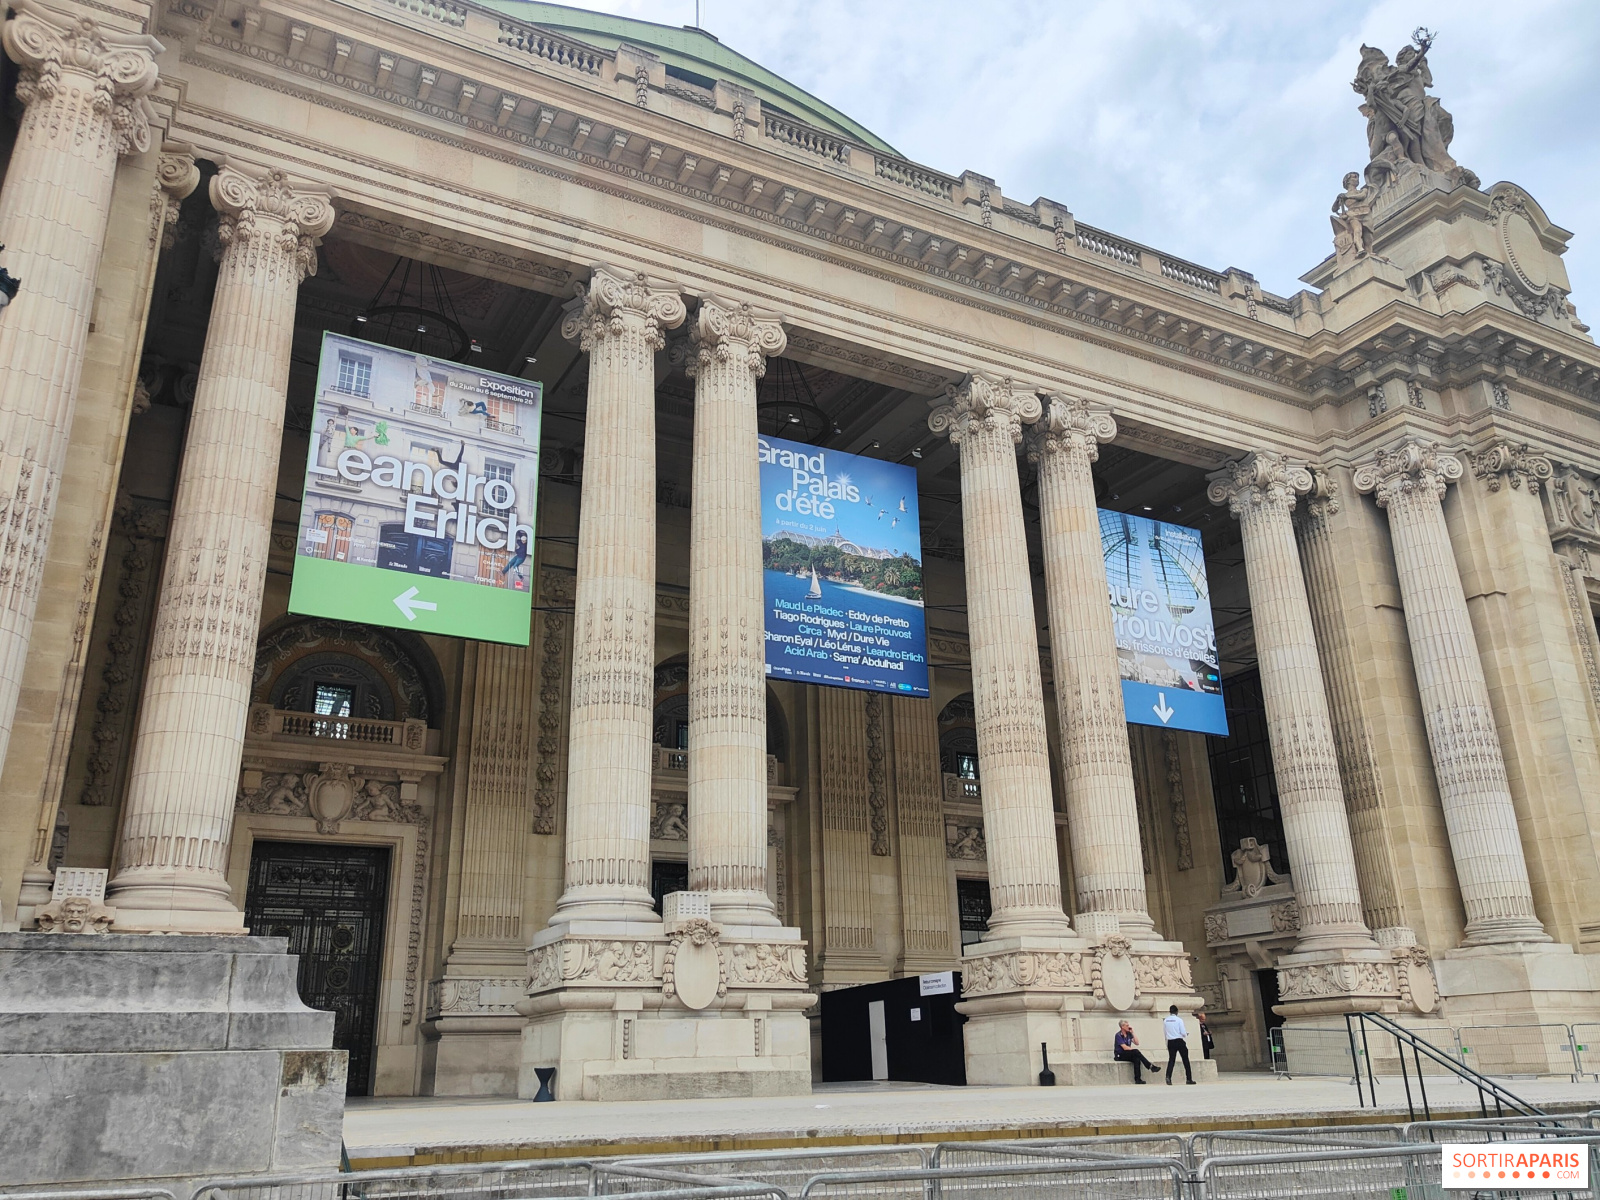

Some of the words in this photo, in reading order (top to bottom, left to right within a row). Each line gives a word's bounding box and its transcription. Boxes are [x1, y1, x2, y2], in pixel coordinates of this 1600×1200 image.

[463, 383, 475, 392] juin
[490, 391, 524, 402] septembre
[480, 378, 534, 398] Exposition
[307, 432, 516, 510] Leandro
[758, 438, 825, 475] Grand
[792, 468, 860, 503] Palais
[775, 489, 835, 520] d'été
[404, 493, 534, 555] Erlich
[800, 521, 808, 529] du
[815, 525, 827, 533] juin
[1108, 583, 1159, 613] aure
[773, 610, 799, 622] Tiago
[800, 613, 845, 629] Rodrigues
[850, 621, 873, 633] Laure
[874, 625, 912, 639] Prouvost
[775, 599, 800, 611] Maud
[802, 602, 812, 612] Le
[814, 604, 844, 617] Pladec
[848, 610, 870, 623] Eddy
[872, 613, 884, 623] de
[884, 616, 910, 628] Pretto
[764, 631, 794, 643] Sharon
[795, 635, 813, 647] Eyal
[819, 638, 836, 649] Léo
[837, 641, 861, 653] Lérus
[866, 646, 901, 659] Leandro
[901, 651, 924, 663] Erlich
[798, 624, 822, 636] Circa
[827, 629, 847, 641] Myd
[853, 632, 874, 644] Dure
[876, 635, 890, 647] Vie
[784, 645, 806, 656] Acid
[806, 648, 828, 659] Arab
[833, 652, 861, 664] Sama'
[861, 656, 904, 671] Abdulhadi
[1116, 639, 1131, 651] us,
[1132, 640, 1173, 657] frissons
[1174, 647, 1216, 663] d'étoiles
